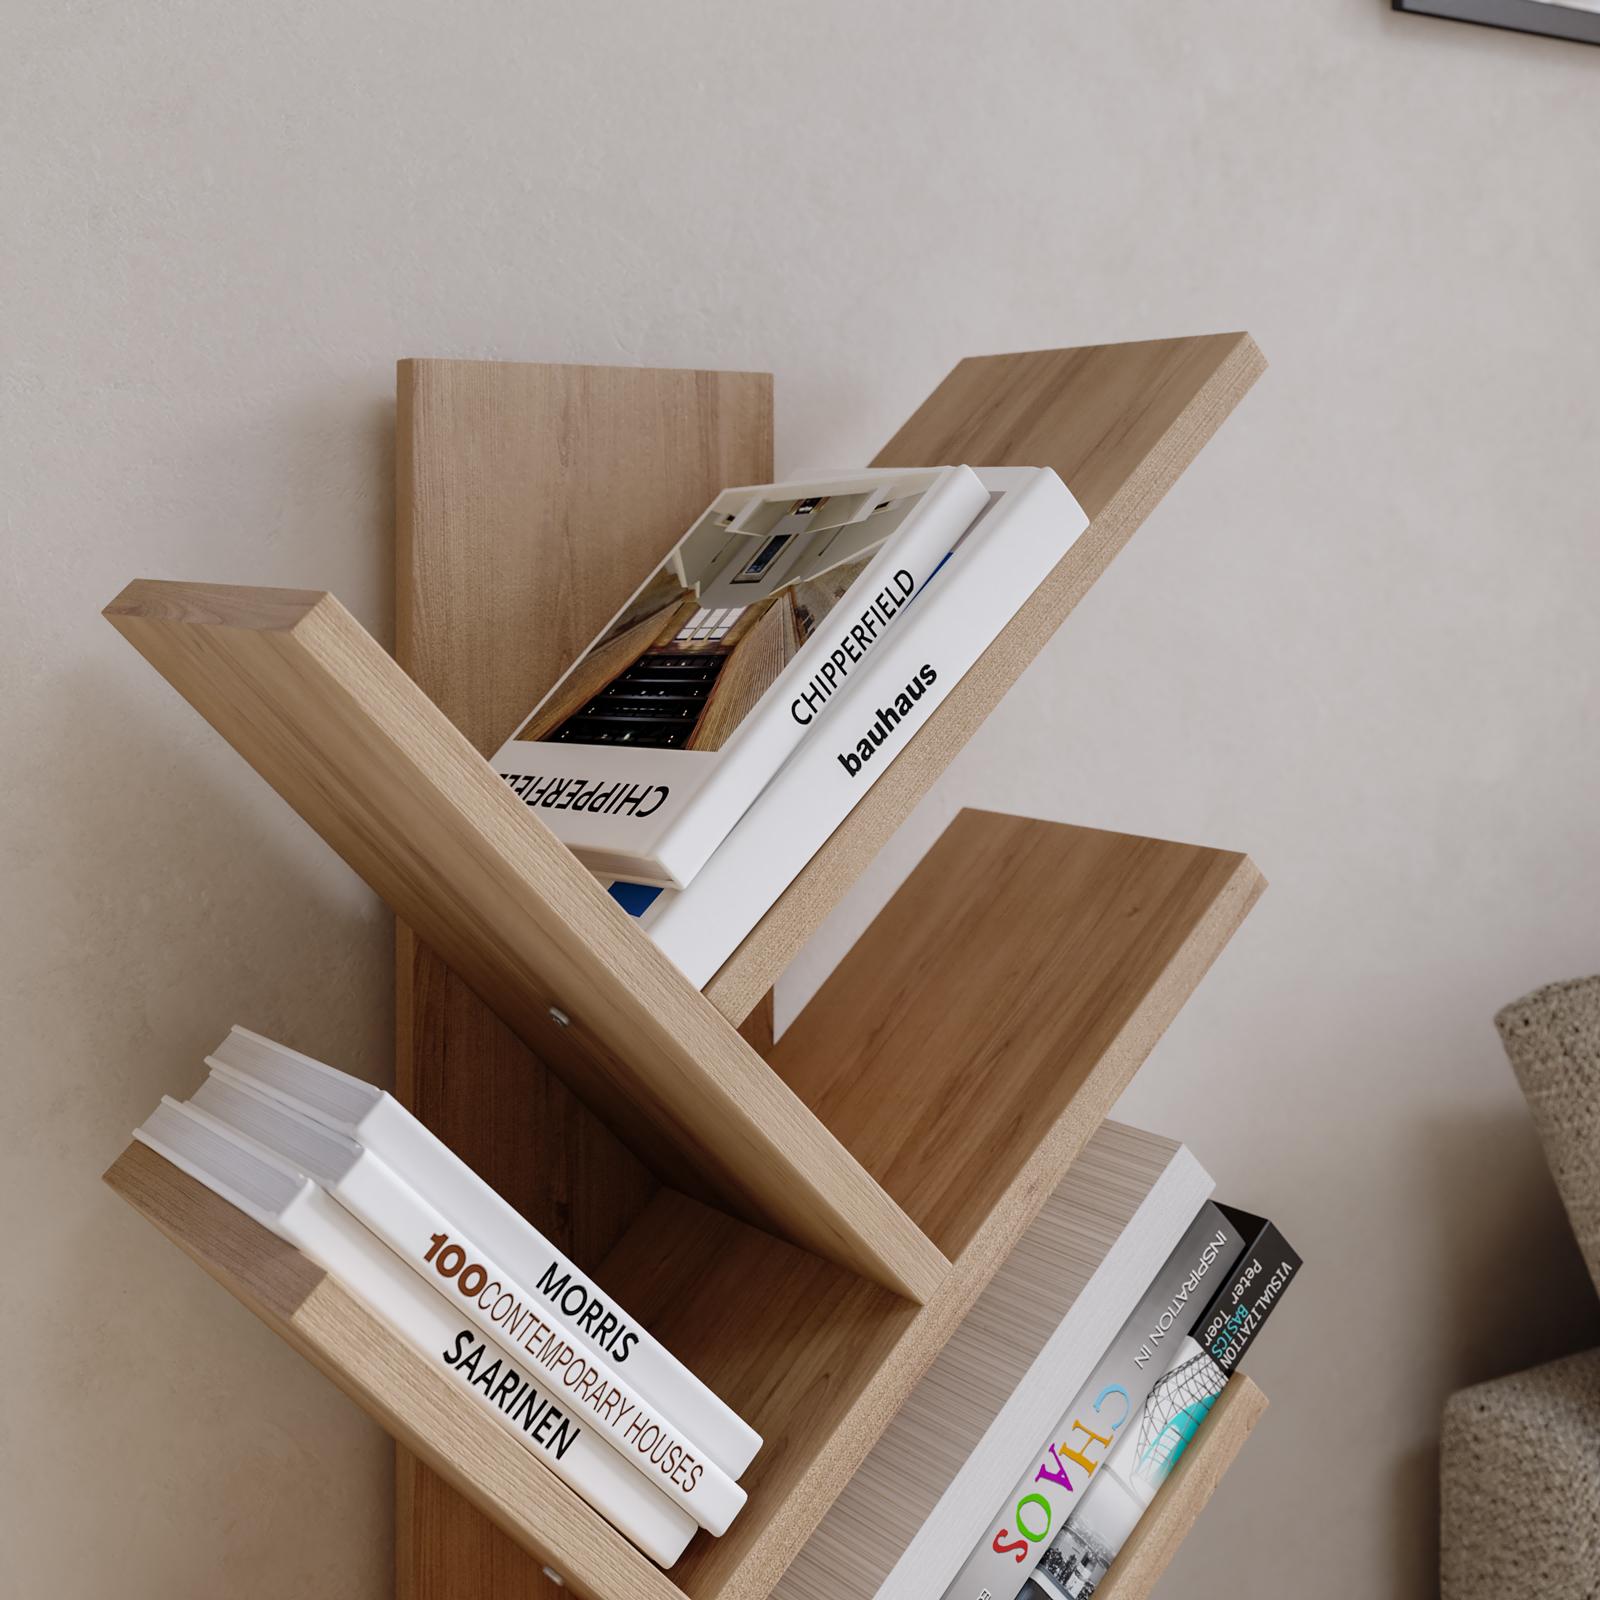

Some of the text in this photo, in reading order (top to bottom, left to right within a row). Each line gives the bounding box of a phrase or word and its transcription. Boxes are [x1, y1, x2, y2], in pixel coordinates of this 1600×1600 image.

[790, 569, 916, 726] CHIPPERFIELD
[837, 664, 938, 778] bauhaus
[499, 773, 670, 818] CHIPPERFIE
[535, 1261, 640, 1363] MORRIS
[1133, 1230, 1228, 1370] INSPIRATION IN
[1203, 1258, 1263, 1347] Peter Toer
[1211, 1304, 1249, 1359] BASICS
[1220, 1261, 1293, 1370] VISUALIZATION
[442, 1329, 581, 1460] SAARINEN
[623, 1411, 704, 1493] HOUSES
[992, 1383, 1131, 1563] CHAOS
